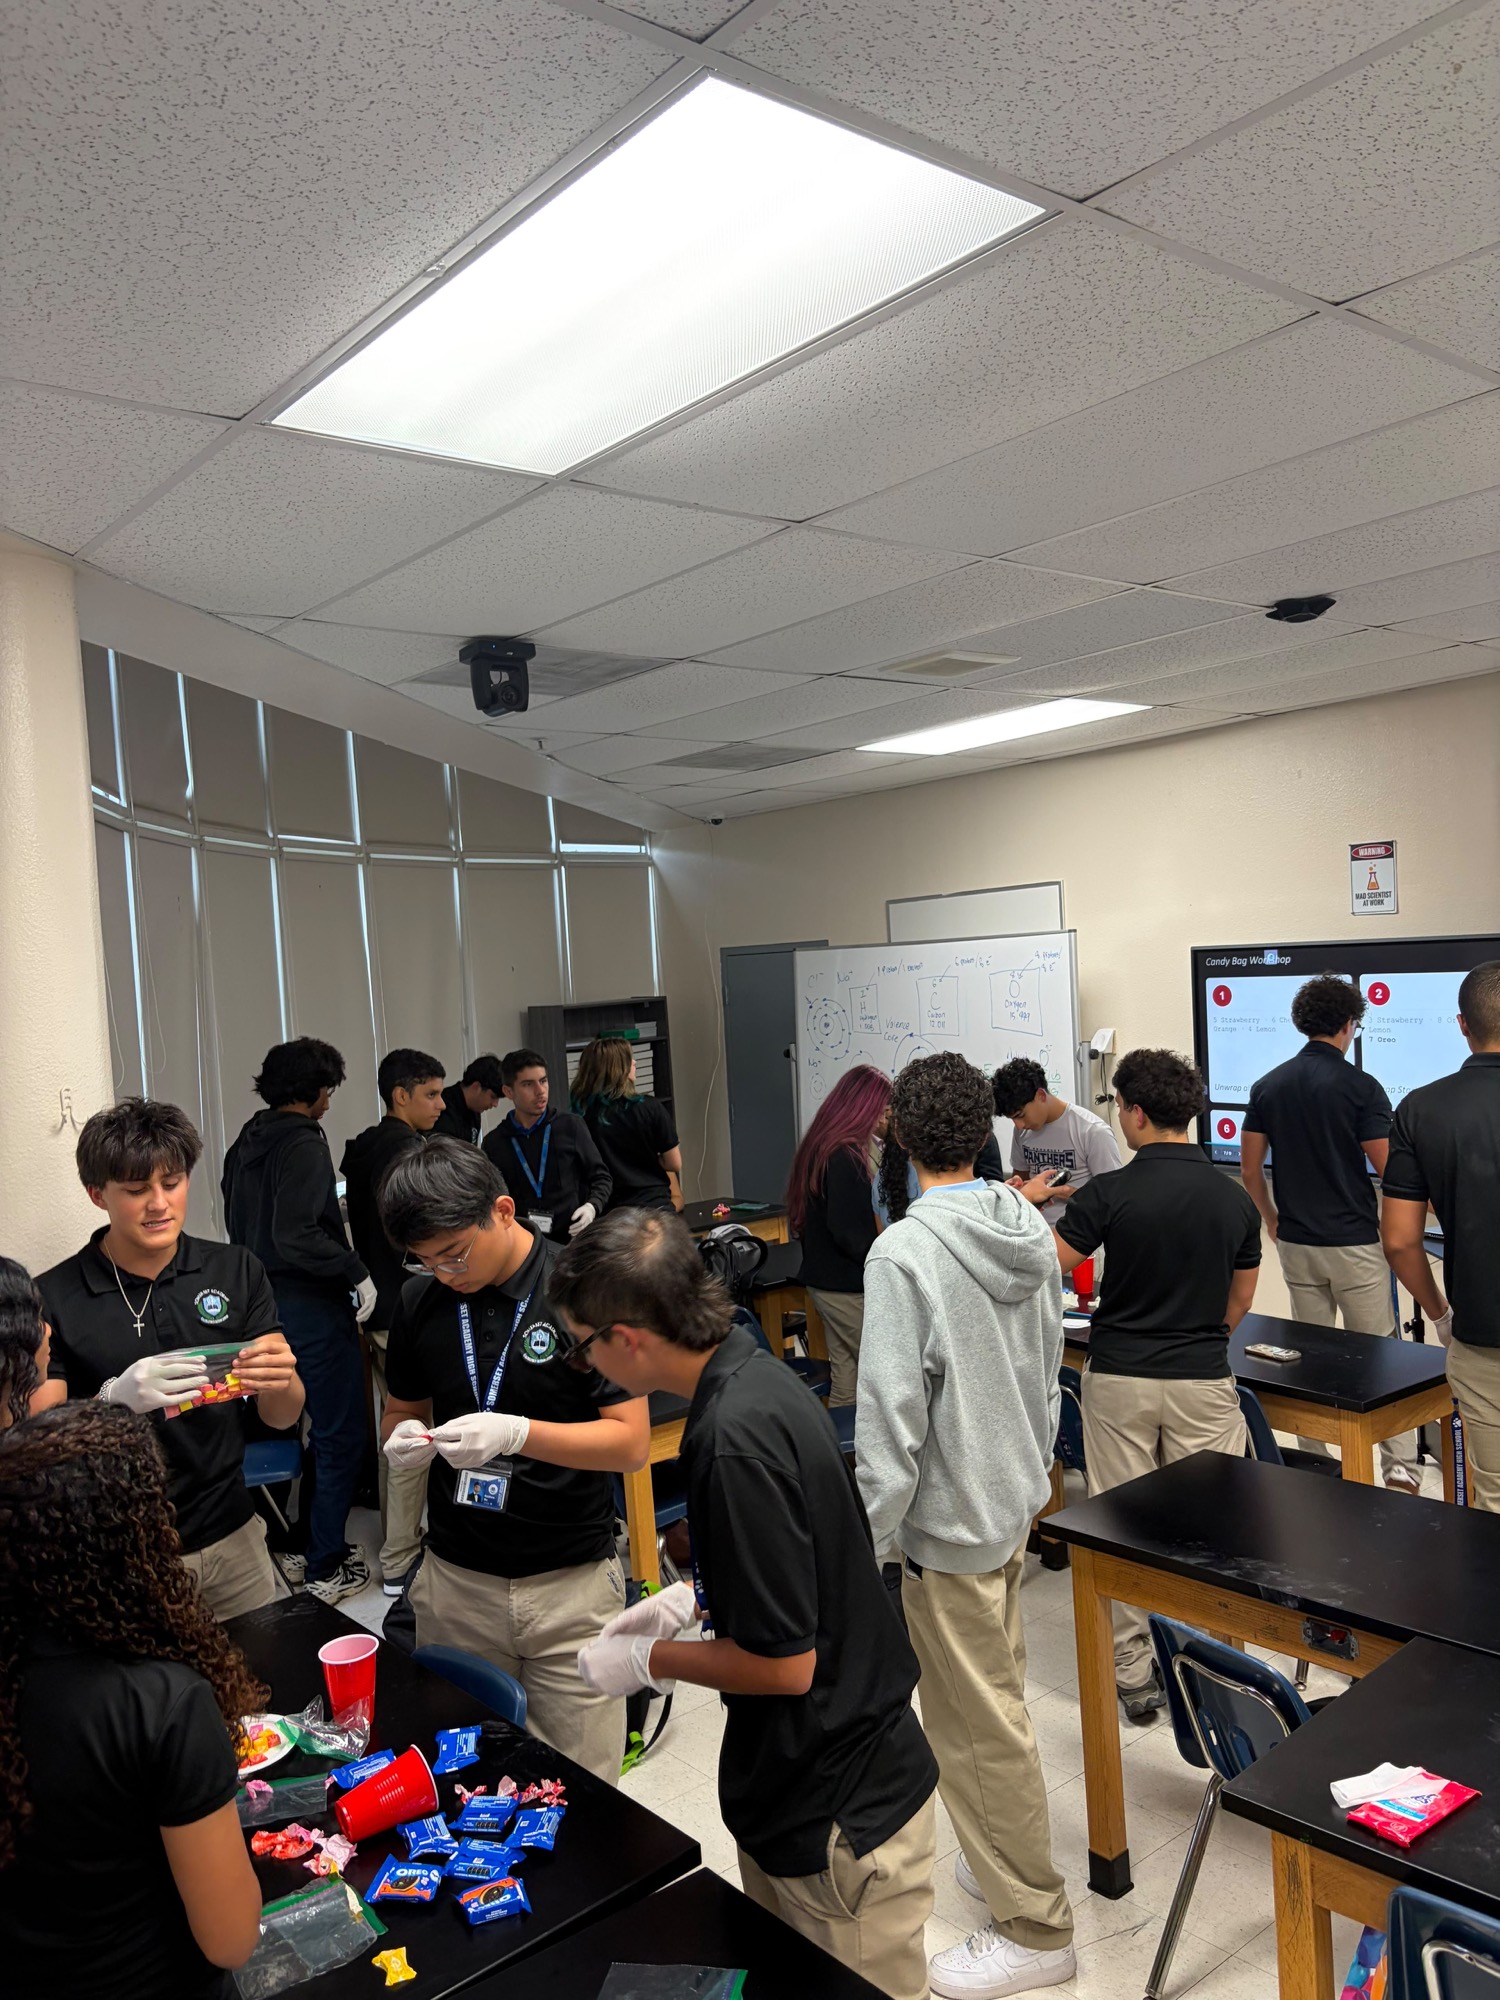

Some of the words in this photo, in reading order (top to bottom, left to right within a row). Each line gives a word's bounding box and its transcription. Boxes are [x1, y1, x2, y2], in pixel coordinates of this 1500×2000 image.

[1358, 847, 1386, 857] WARNING
[1355, 892, 1367, 900] MAD
[1367, 891, 1392, 899] SCIENTIST
[1205, 956, 1230, 967] Candy
[1231, 956, 1248, 967] Bag
[1249, 955, 1291, 966] Worhop
[1219, 990, 1225, 1001] 1
[1375, 988, 1383, 999] 2
[927, 1010, 946, 1018] Carbon
[885, 1018, 910, 1030] Valence
[1220, 1016, 1261, 1024] Strawberry
[1377, 1016, 1424, 1025] Strawberry
[884, 1032, 899, 1042] Core
[1214, 1083, 1242, 1093] Unwrap
[1223, 1123, 1231, 1134] 6
[1024, 1147, 1074, 1169] PANTHERS
[462, 1318, 474, 1354] ACADEMY
[466, 1354, 476, 1376] HIGH
[486, 1367, 504, 1406] SOMERSET
[1454, 1429, 1462, 1450] SCHOOL
[1456, 1464, 1464, 1489] ACADEMY
[396, 1868, 429, 1876] OREO
